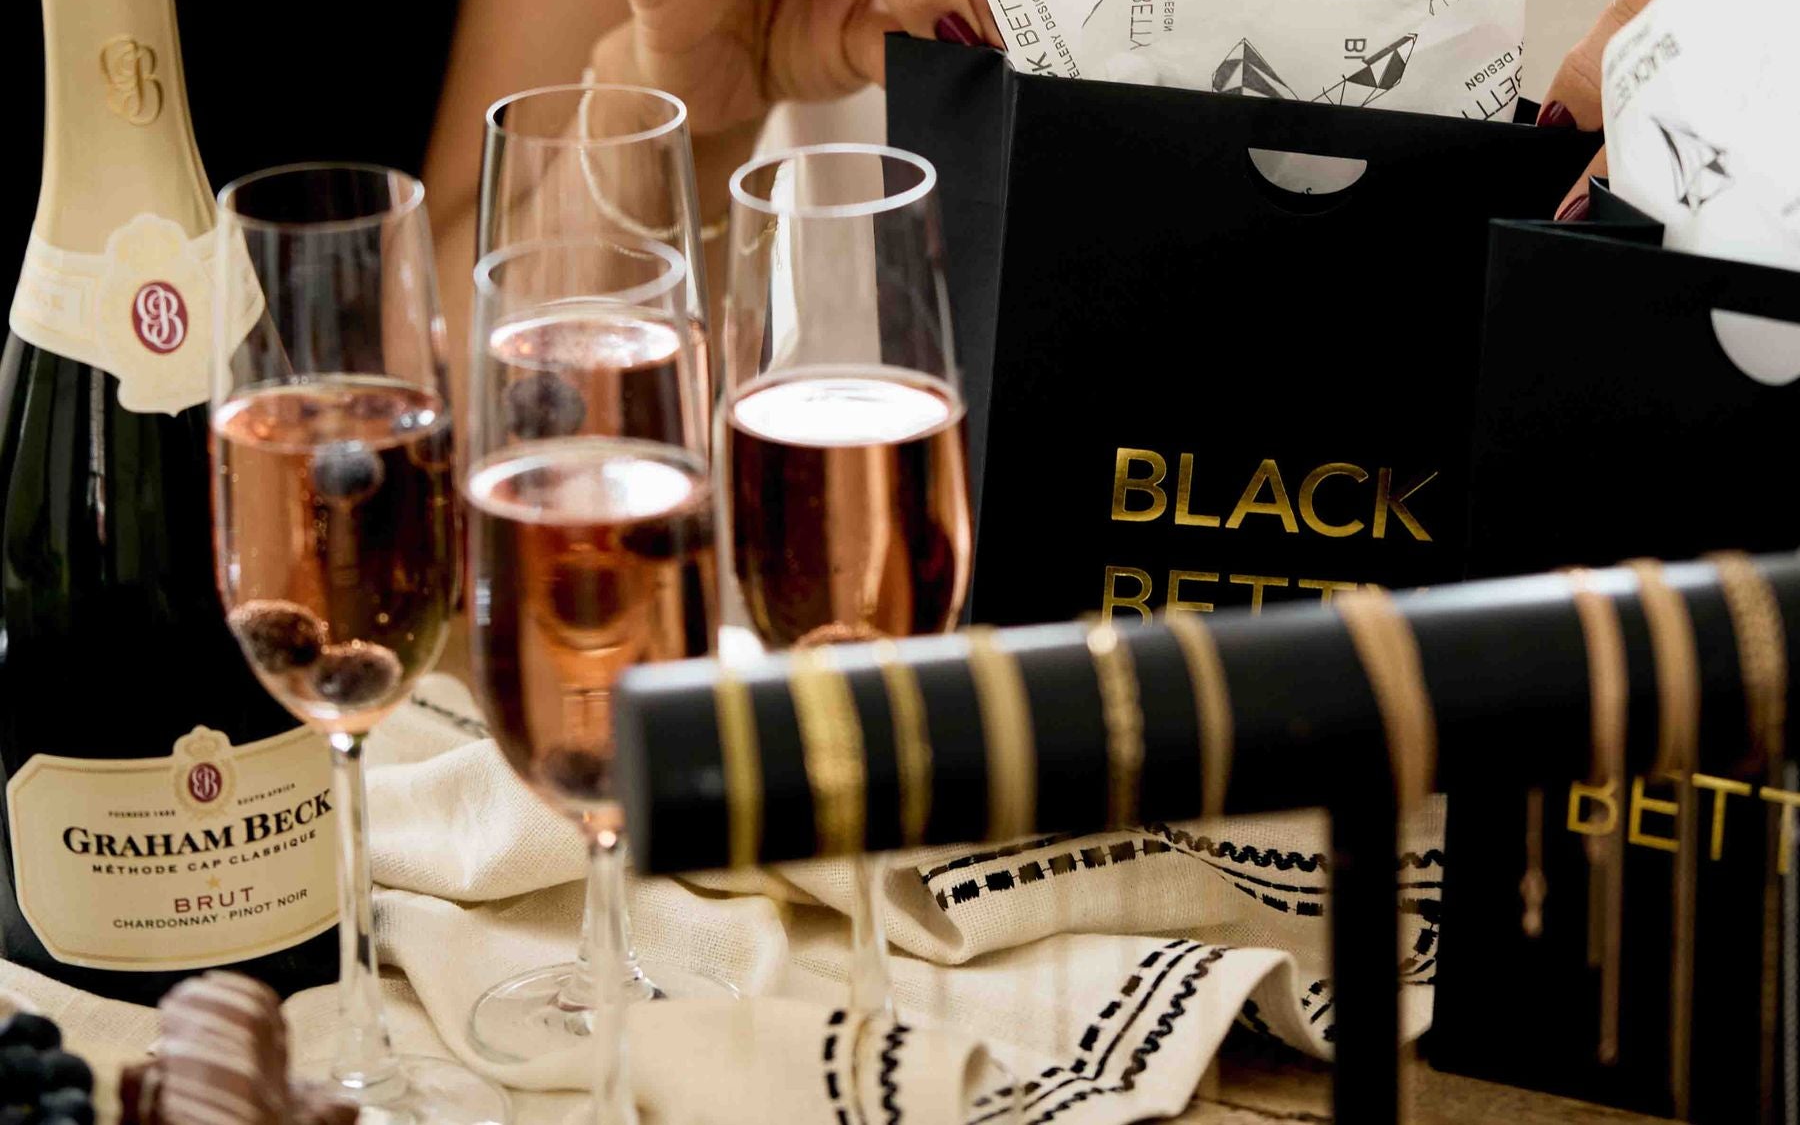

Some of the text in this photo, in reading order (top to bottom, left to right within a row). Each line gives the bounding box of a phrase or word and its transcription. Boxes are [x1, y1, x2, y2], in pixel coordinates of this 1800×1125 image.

[1464, 52, 1514, 92] DESIGN
[1111, 447, 1439, 542] BLACK
[1102, 565, 1430, 628] BETT
[63, 788, 333, 858] GRAHAM BECK
[92, 829, 317, 875] MÉTHODE CAP CLASSIQUE
[113, 888, 308, 929] CHARDONNAY PINOT NOIR
[174, 887, 255, 914] BRUT
